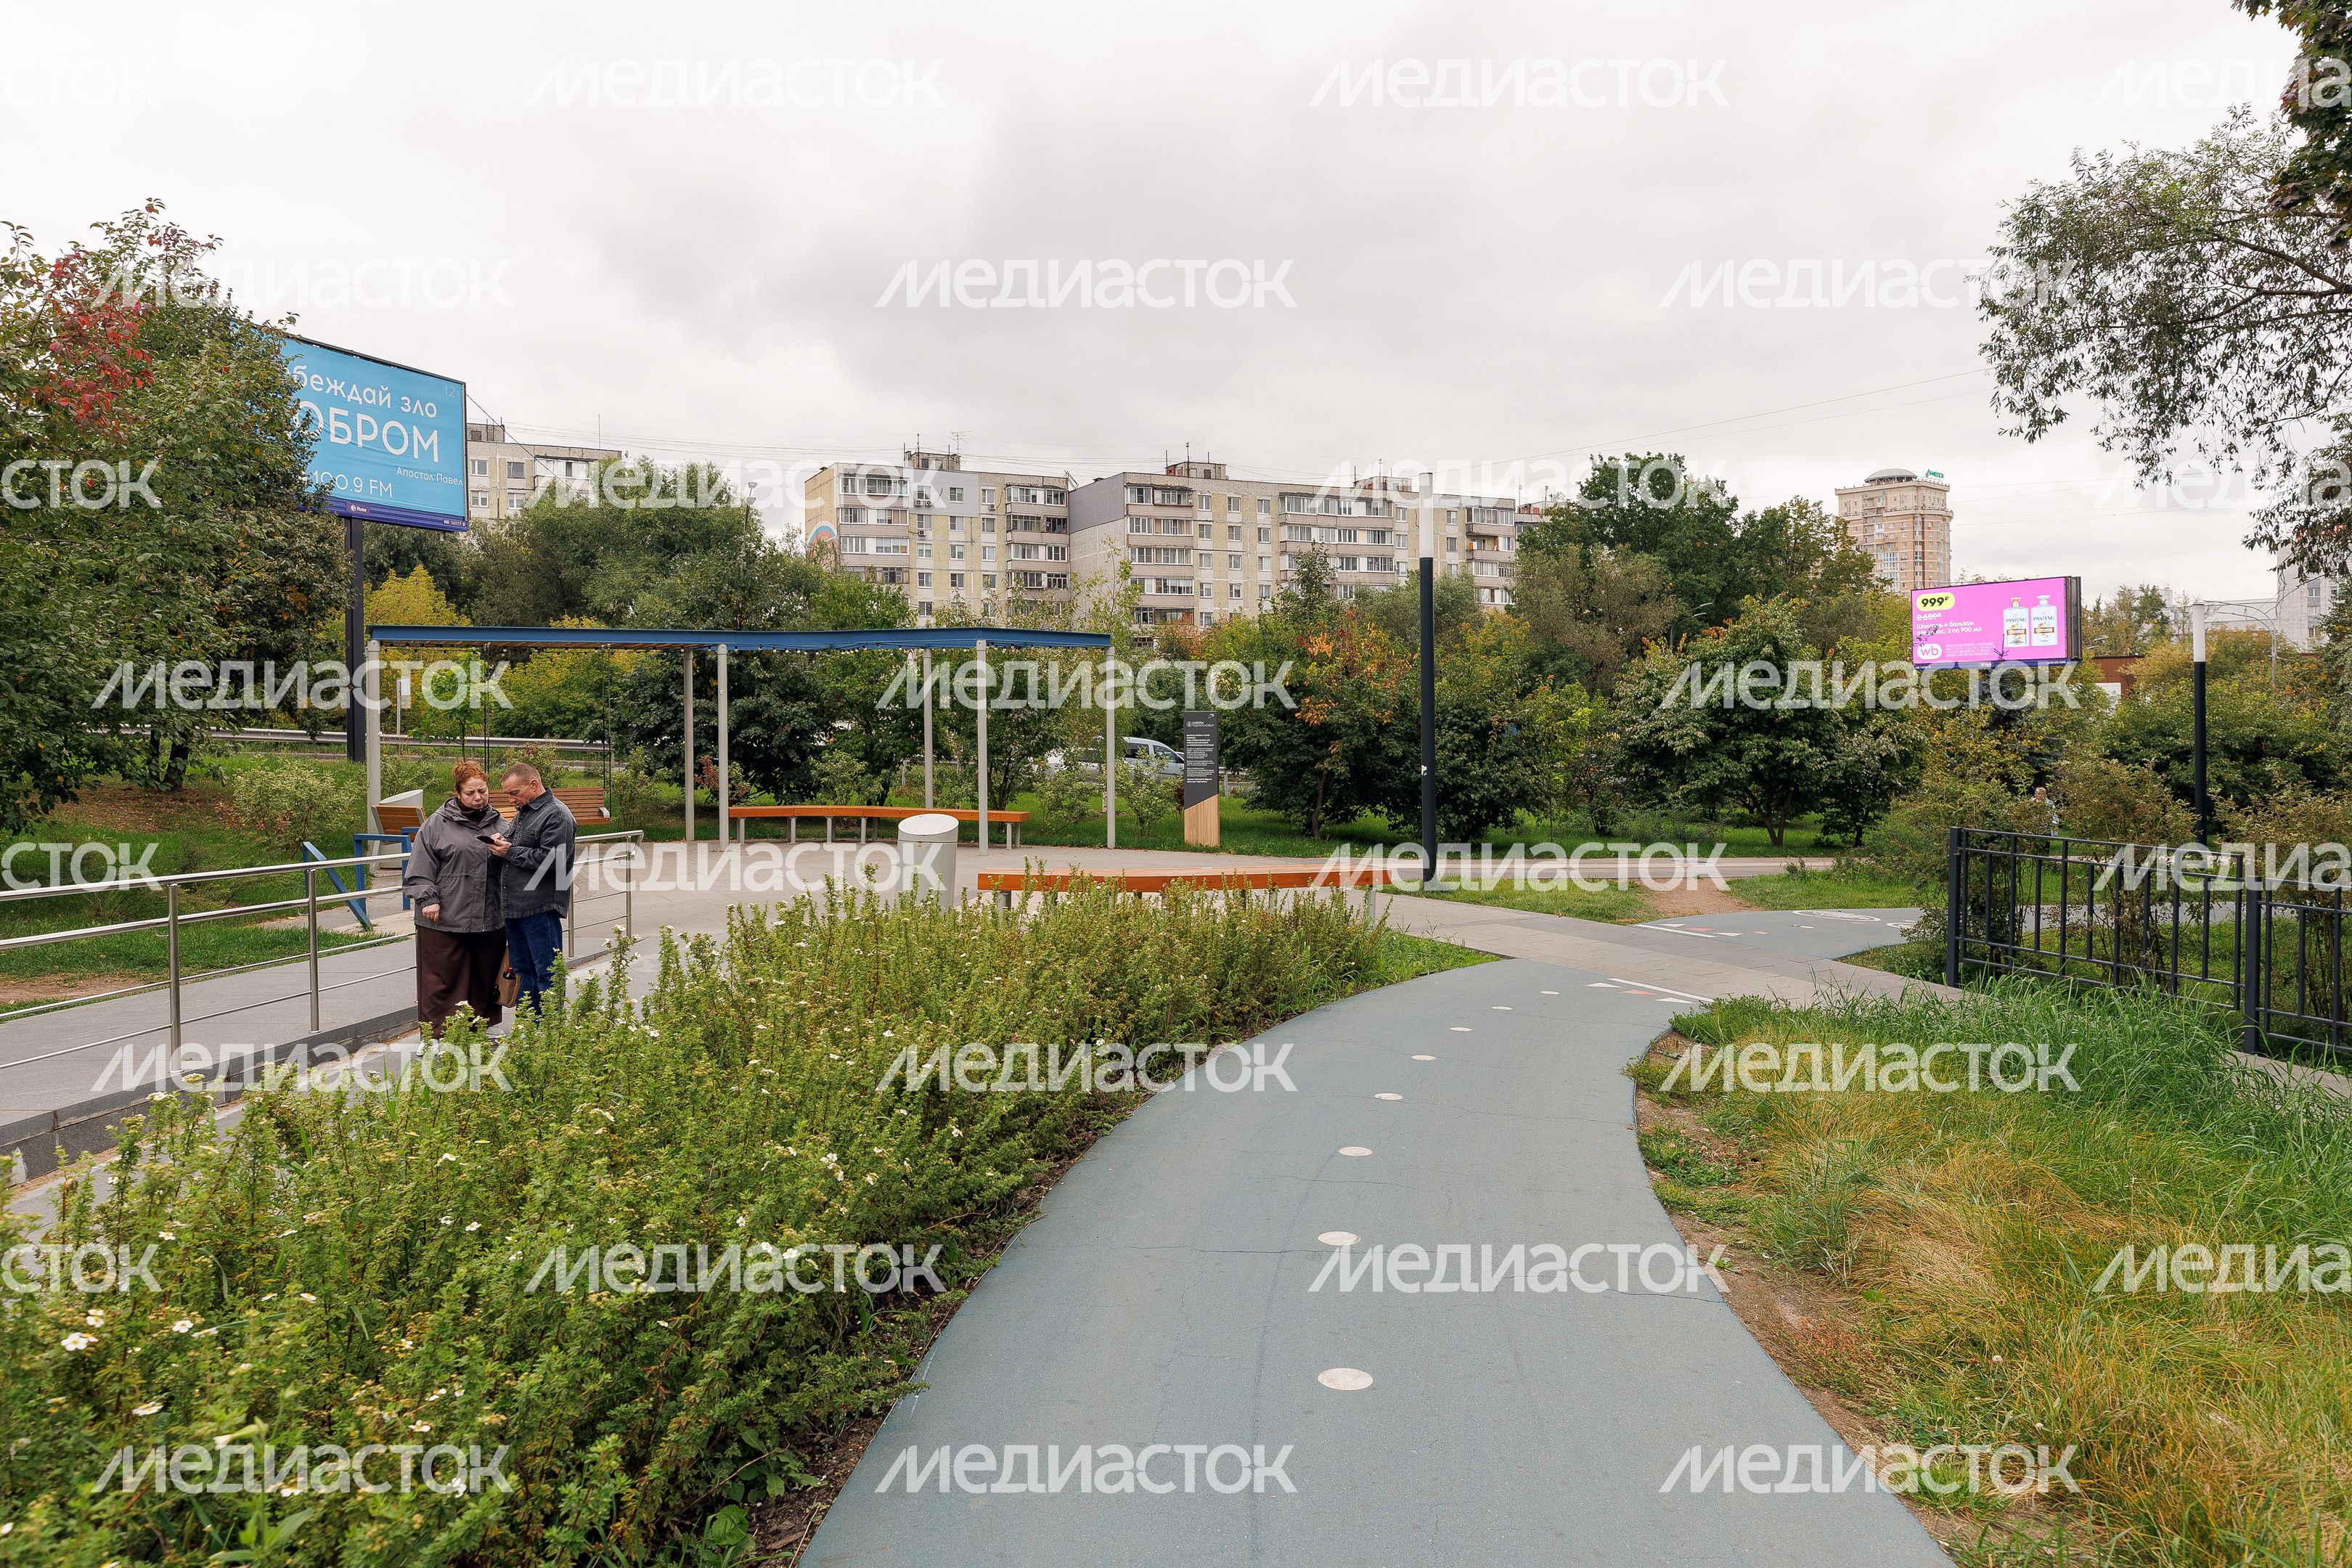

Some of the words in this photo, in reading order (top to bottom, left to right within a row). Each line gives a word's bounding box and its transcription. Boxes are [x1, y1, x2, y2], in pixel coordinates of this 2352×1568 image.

[287, 364, 391, 408] беждай
[400, 396, 437, 419] зло
[444, 385, 461, 399] 12+
[294, 401, 439, 463] ОБРОМ
[396, 466, 434, 481] Апостол
[436, 473, 463, 486] Павел
[369, 479, 392, 498] FM
[1921, 645, 1939, 656] wb
